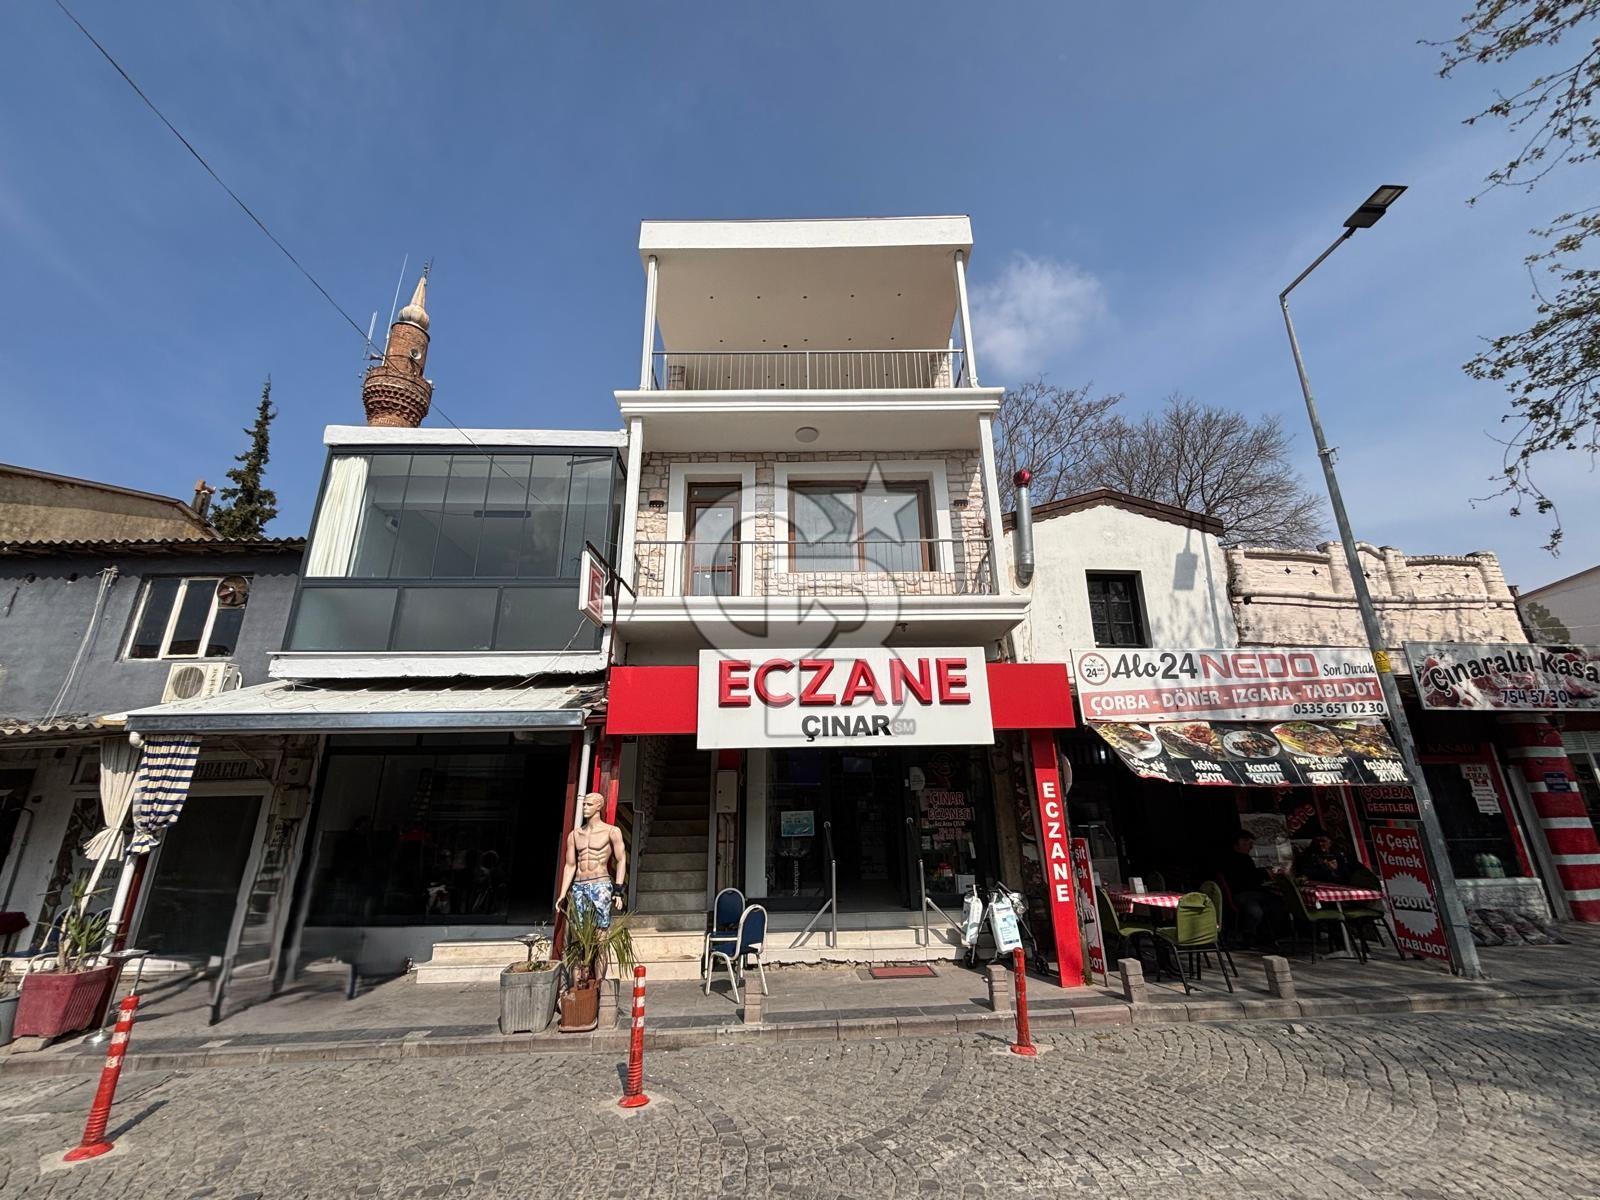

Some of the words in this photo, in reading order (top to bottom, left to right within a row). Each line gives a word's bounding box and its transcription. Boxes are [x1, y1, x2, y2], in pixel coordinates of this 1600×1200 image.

[1086, 668, 1097, 678] 24
[1200, 653, 1320, 679] NEDO
[1324, 663, 1341, 676] Son
[1343, 662, 1375, 675] Durak
[1429, 650, 1535, 696] Çınaraltı
[718, 658, 971, 708] ECZANE
[1091, 694, 1149, 716] ÇORBA
[1161, 689, 1221, 708] DÖNER
[1232, 686, 1294, 703] IZGARA
[1303, 681, 1376, 699] TABLDOT
[1501, 690, 1527, 704] 754
[1530, 690, 1546, 703] 57
[1549, 690, 1569, 703] 30
[1293, 703, 1323, 714] 0535
[1326, 703, 1347, 714] 651
[1352, 703, 1366, 713] 02
[1369, 702, 1384, 713] 30
[802, 715, 891, 742] ÇINAR
[1191, 759, 1222, 772] köfte
[1244, 761, 1281, 773] kanat
[1376, 769, 1408, 782] 200TL
[930, 792, 965, 808] ÇINAR
[1362, 786, 1413, 803] ÇORBA
[1042, 782, 1070, 902] ECZANE
[1376, 832, 1384, 845] 4
[1386, 834, 1419, 852] Çeşit
[1379, 851, 1423, 869] Yemek
[1394, 896, 1434, 912] 200TL
[1399, 936, 1448, 957] TABLDOT
